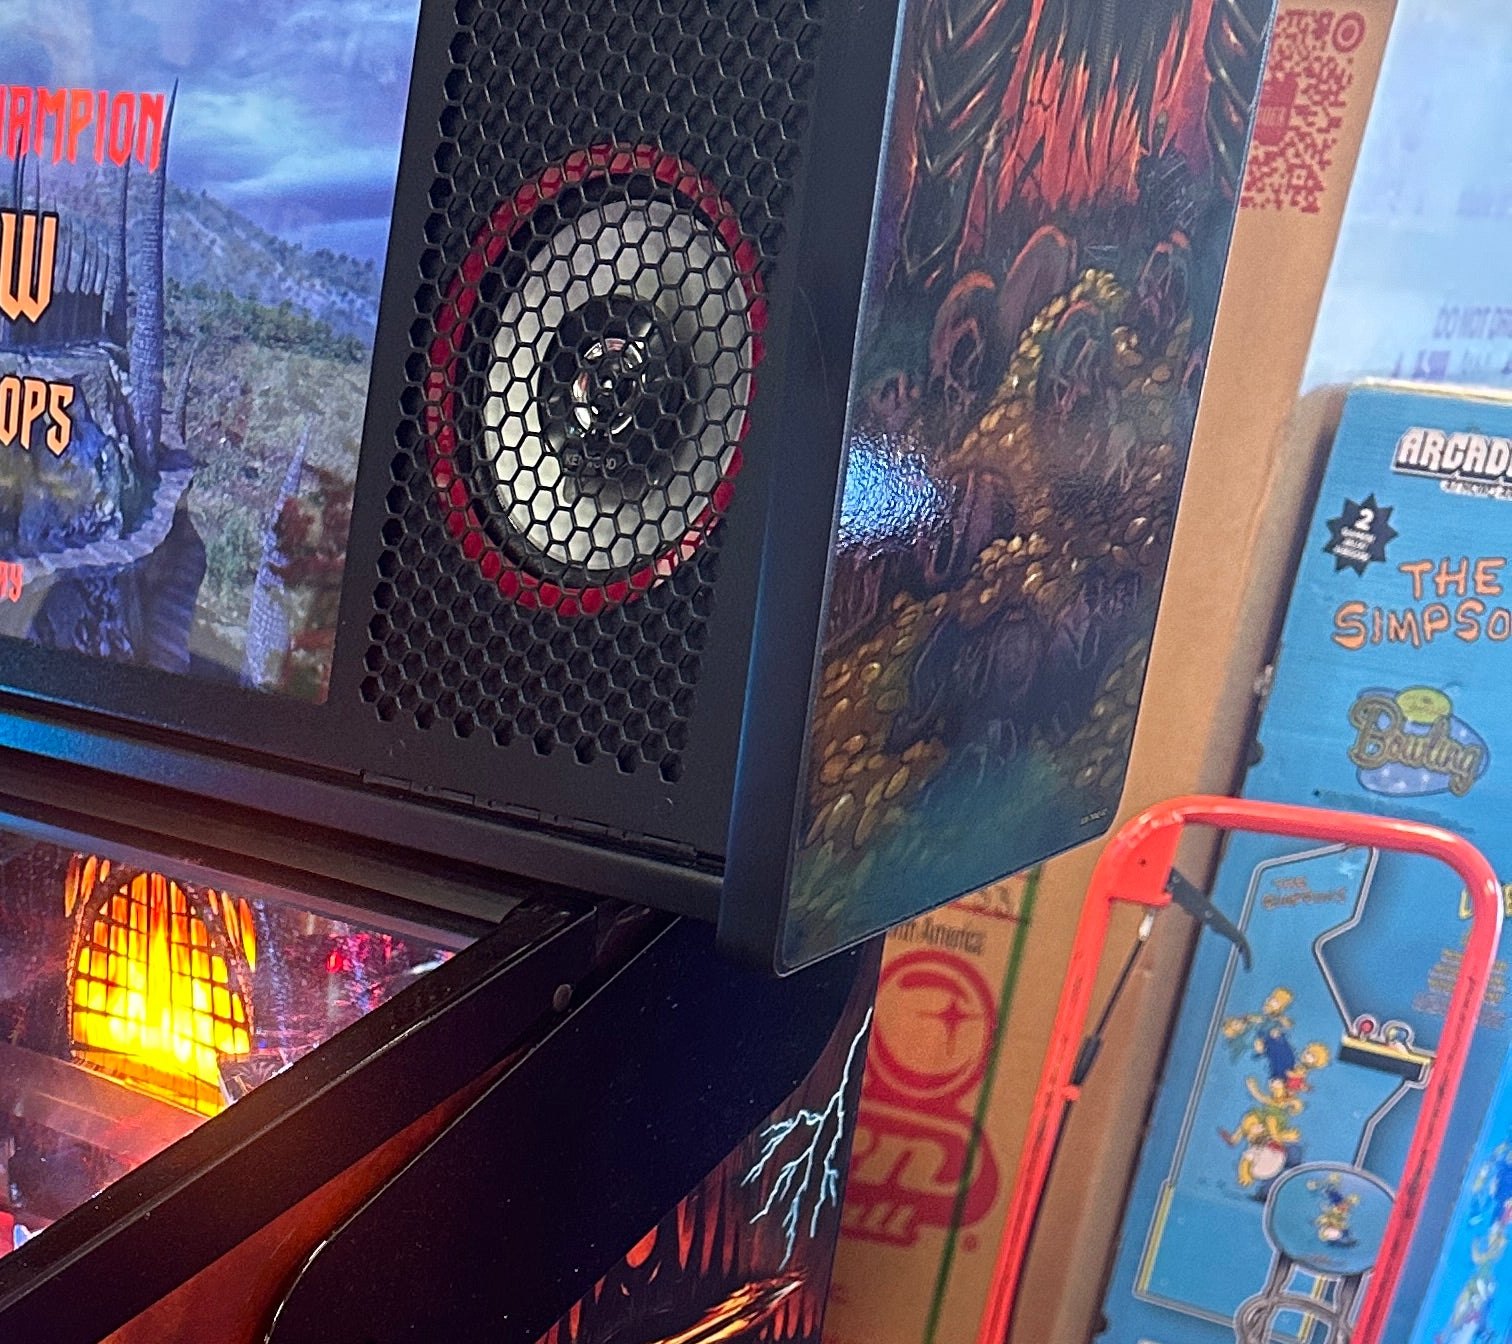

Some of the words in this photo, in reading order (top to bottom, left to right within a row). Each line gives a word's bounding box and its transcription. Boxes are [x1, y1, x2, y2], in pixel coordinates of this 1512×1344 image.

[1395, 428, 1512, 480] ARCAD
[1355, 508, 1375, 530] 2
[1398, 556, 1507, 600] THE
[1333, 597, 1512, 650] SIMPSO
